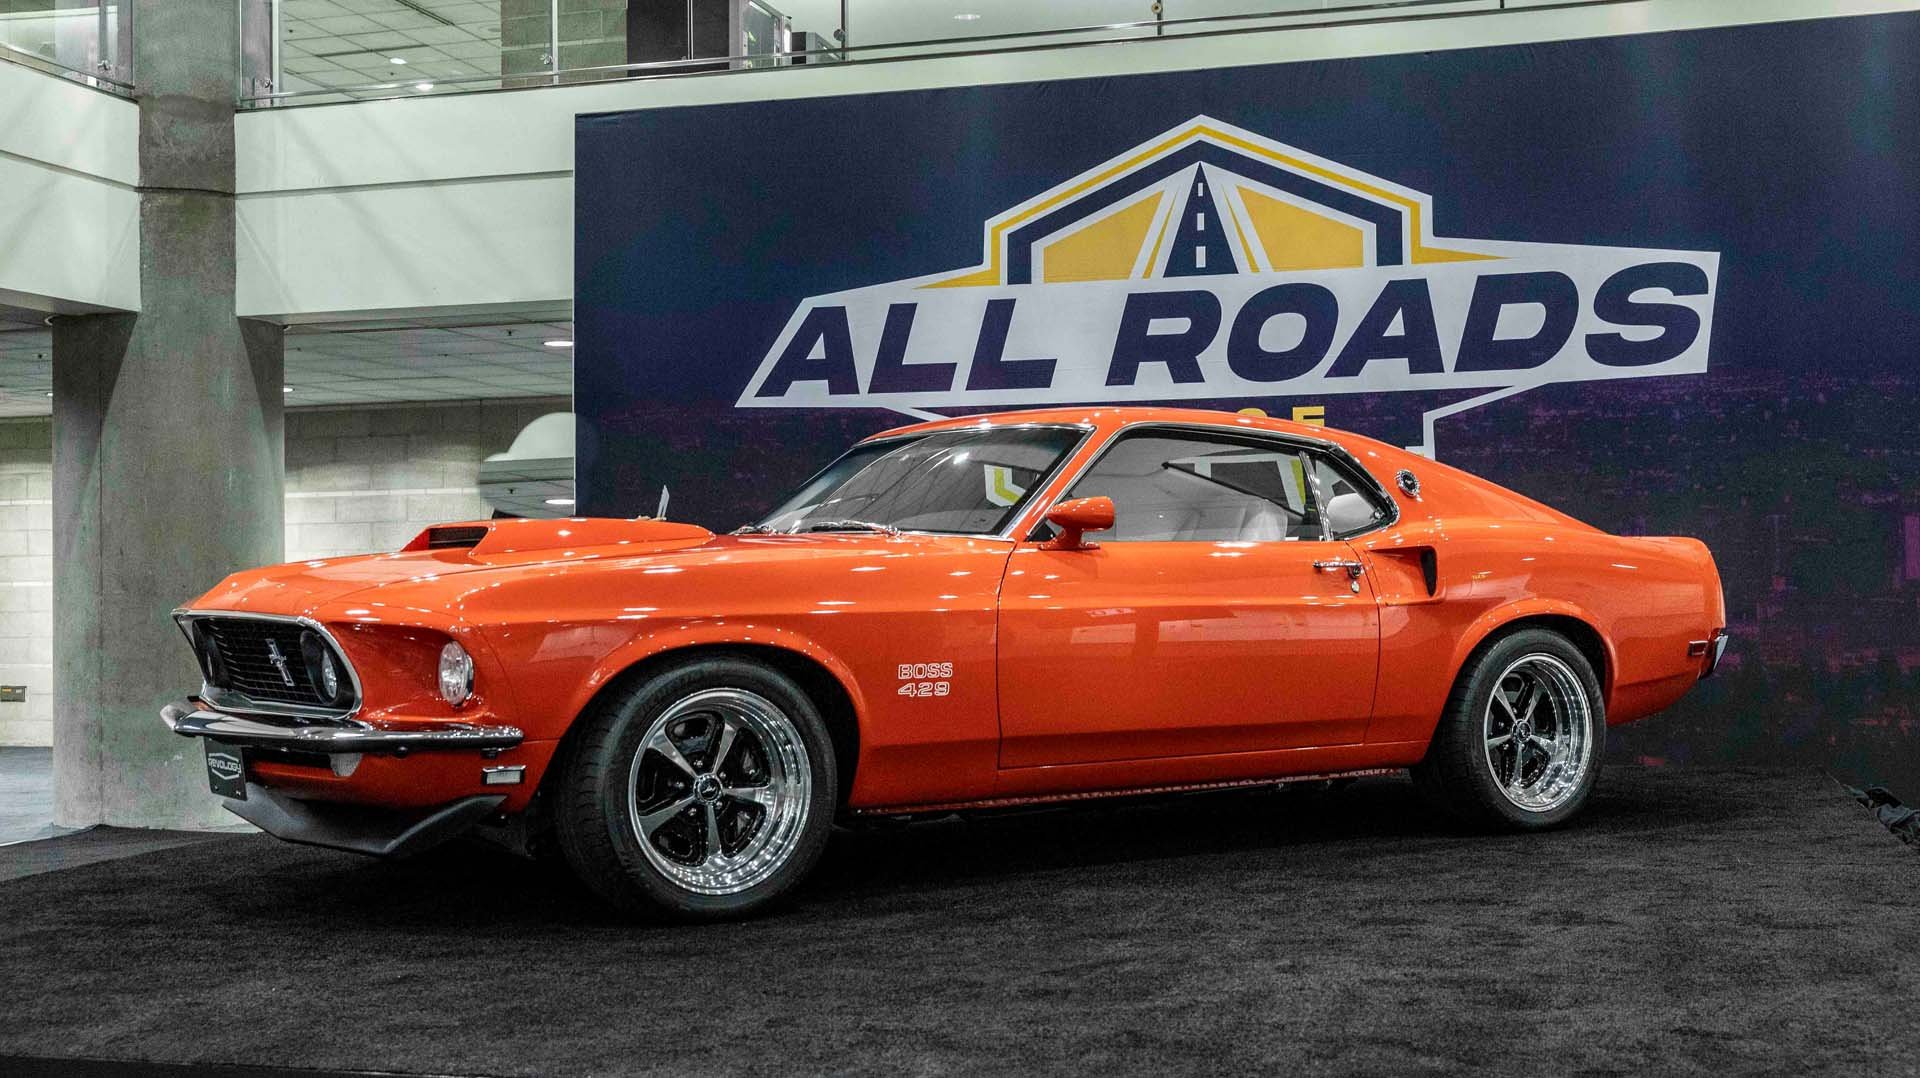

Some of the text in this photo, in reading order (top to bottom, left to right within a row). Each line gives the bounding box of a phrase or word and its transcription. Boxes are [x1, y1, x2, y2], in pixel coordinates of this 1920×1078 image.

[755, 261, 1709, 398] ALL ROADS
[898, 662, 953, 679] BOSS
[898, 682, 950, 697] 429
